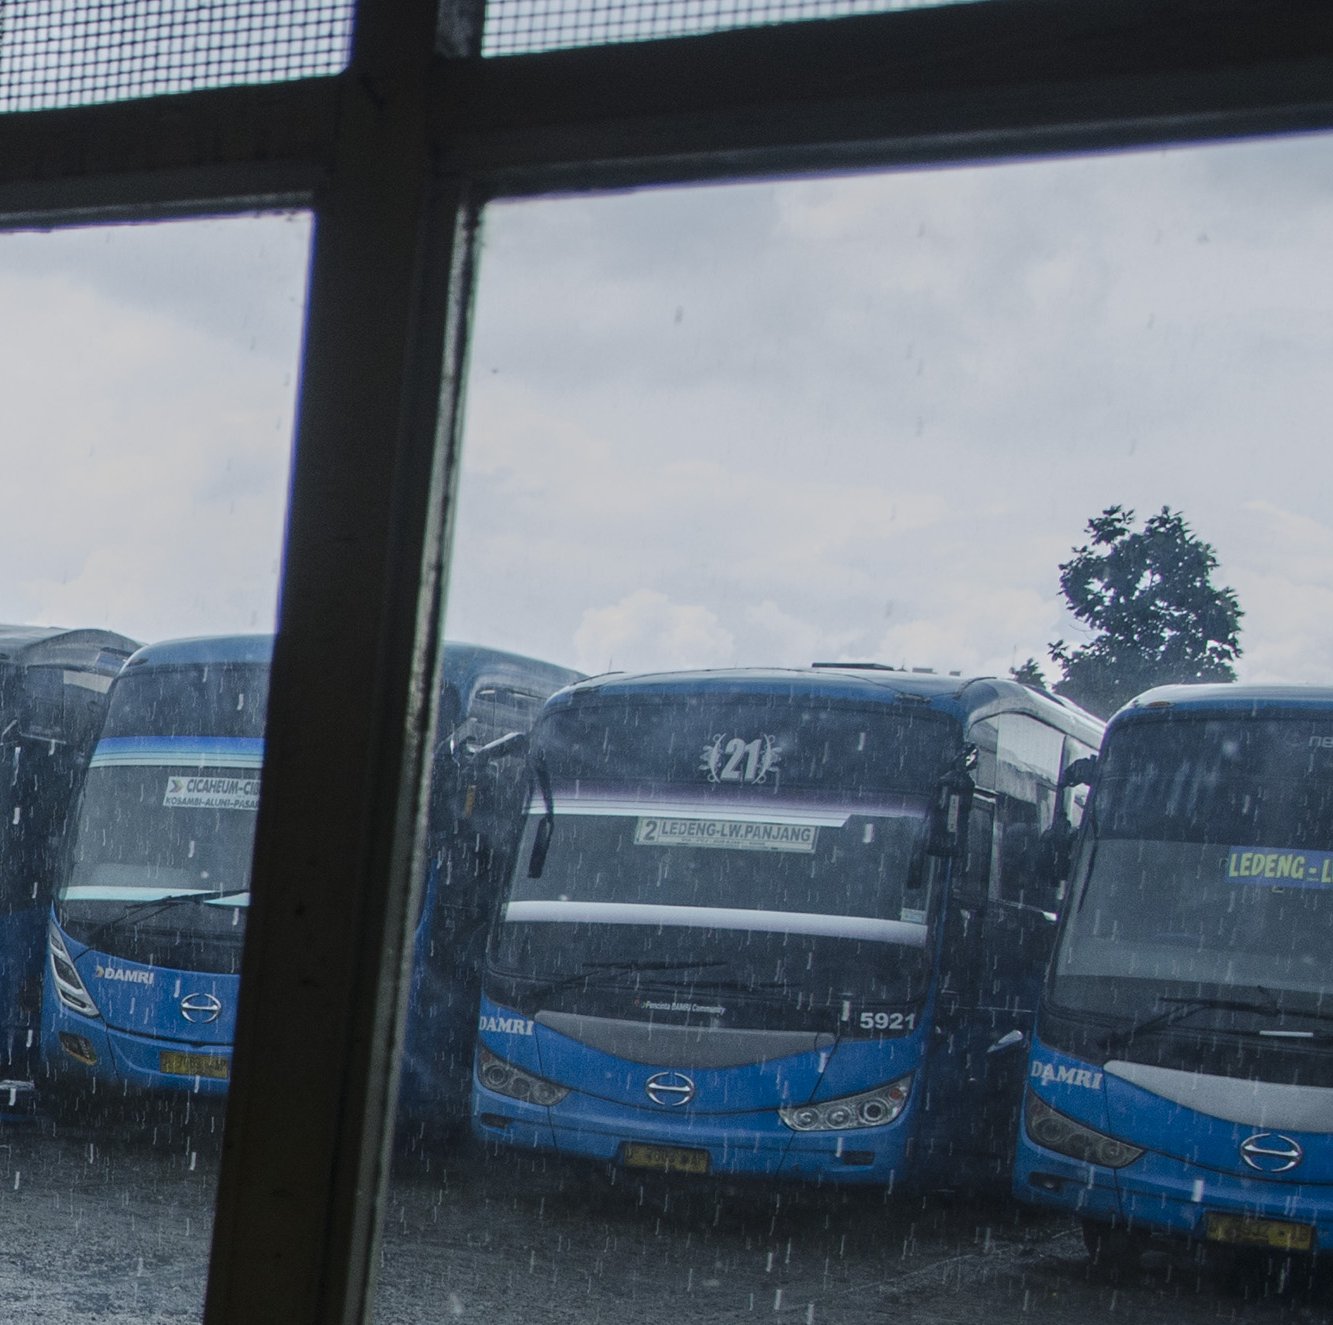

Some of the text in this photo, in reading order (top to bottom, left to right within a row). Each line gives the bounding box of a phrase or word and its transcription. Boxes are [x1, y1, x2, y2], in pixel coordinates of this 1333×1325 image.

[720, 737, 763, 782] 21
[642, 820, 658, 841] 2
[1229, 852, 1306, 880] LEDENG
[104, 967, 155, 985] DAMRI
[478, 1015, 535, 1036] DAMRI
[859, 1011, 917, 1030] 5921
[1031, 1060, 1104, 1090] DAMRI
